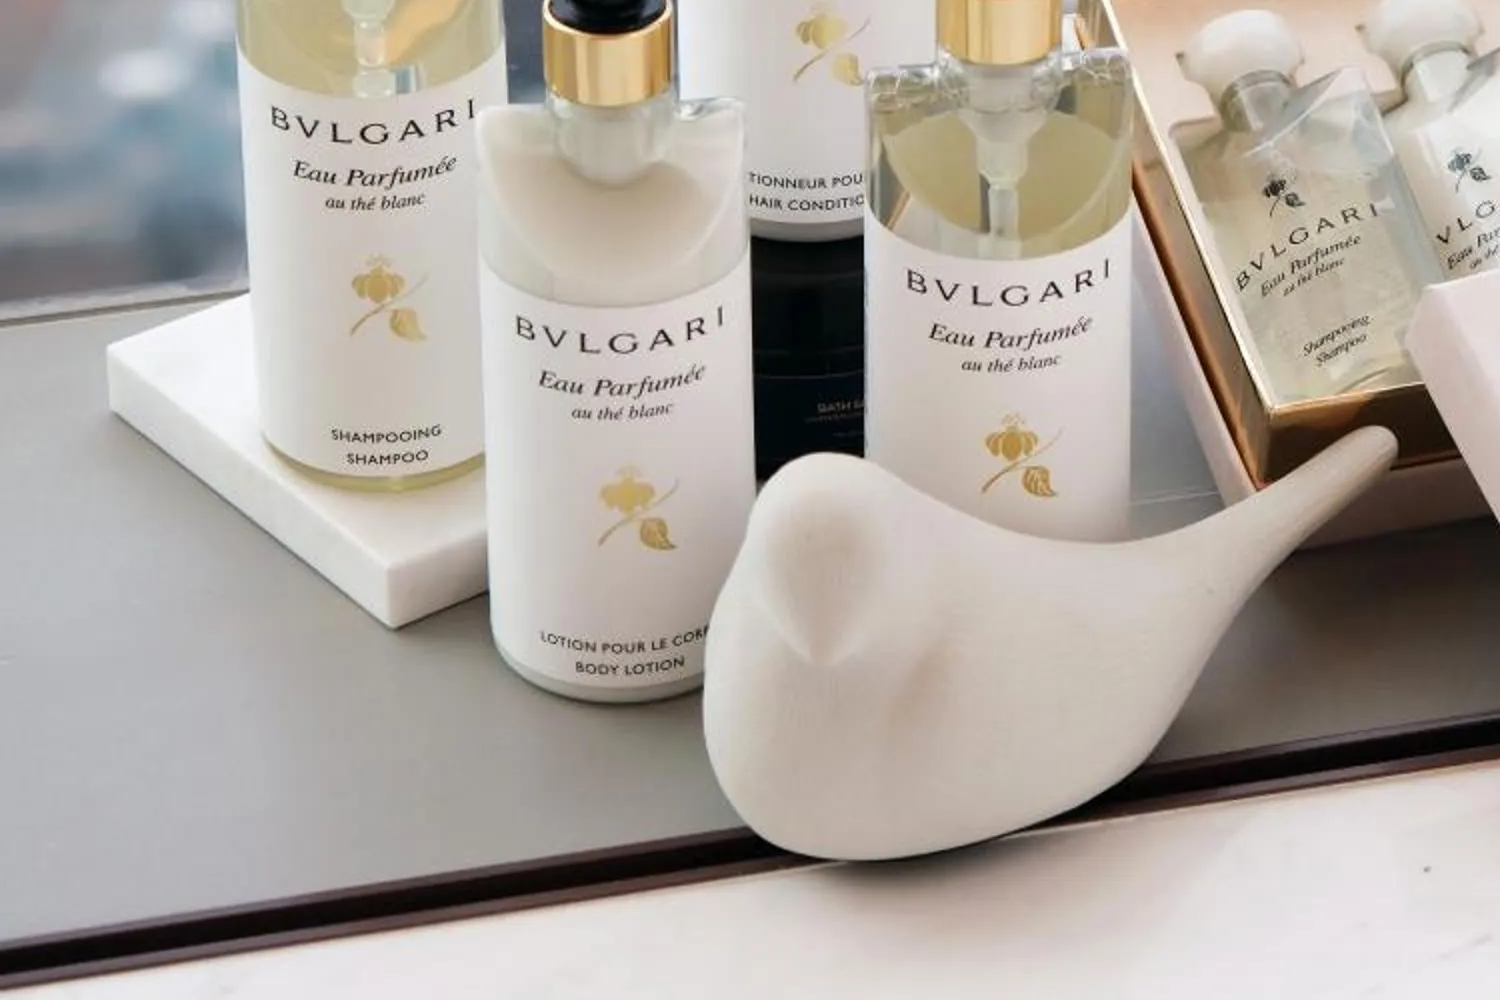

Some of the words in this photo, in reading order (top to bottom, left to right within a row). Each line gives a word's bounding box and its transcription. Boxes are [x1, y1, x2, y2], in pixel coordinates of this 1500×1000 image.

[271, 98, 475, 145] BVLGARI
[293, 159, 337, 185] Eau
[346, 155, 458, 192] Parfumée
[749, 171, 827, 190] TIONNEUR
[831, 172, 863, 188] POU
[325, 196, 345, 210] au
[350, 194, 376, 212] thé
[380, 192, 426, 210] blanc
[749, 193, 783, 210] HAIR
[787, 193, 865, 212] CONDITIO
[1235, 203, 1379, 291] BVLGARI
[1447, 244, 1474, 270] Eau
[1261, 271, 1286, 298] Eau
[1290, 235, 1362, 275] Parfumée
[906, 258, 1111, 308] BVLGARI
[515, 305, 724, 355] BVLGARI
[928, 322, 976, 348] Eau
[983, 315, 1094, 351] Parfumée
[1302, 314, 1371, 357] Shampooing
[961, 359, 982, 373] au
[987, 357, 1013, 374] thé
[1017, 353, 1062, 372] blanc
[1315, 333, 1368, 367] Shampoo
[538, 369, 584, 396] Eau
[593, 363, 706, 400] Parfumée
[571, 407, 592, 420] au
[597, 405, 623, 422] thé
[628, 403, 674, 420] blanc
[331, 423, 442, 444] SHAMPOOING
[346, 449, 429, 466] SHAMPOO
[540, 630, 598, 654] LOTION
[601, 642, 646, 655] POUR
[651, 637, 668, 651] LE
[575, 661, 621, 676] BODY
[625, 656, 685, 676] LOTION
